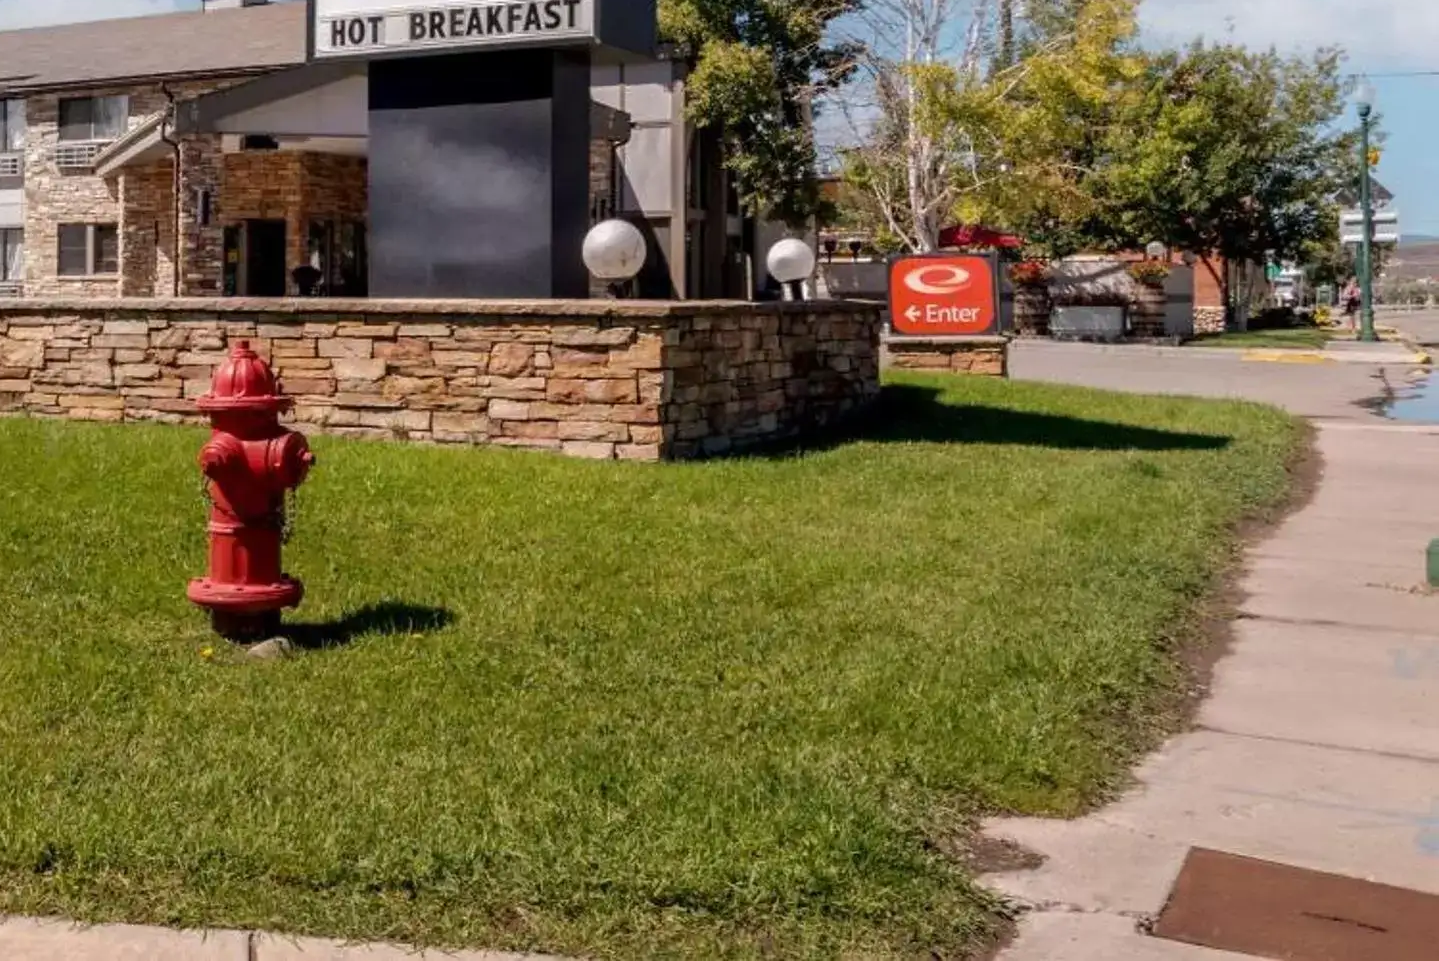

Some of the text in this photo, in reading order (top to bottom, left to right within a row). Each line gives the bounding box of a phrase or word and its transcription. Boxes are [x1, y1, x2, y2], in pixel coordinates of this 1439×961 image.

[331, 0, 581, 47] HOT BREAKFAST
[926, 303, 980, 323] Enter
